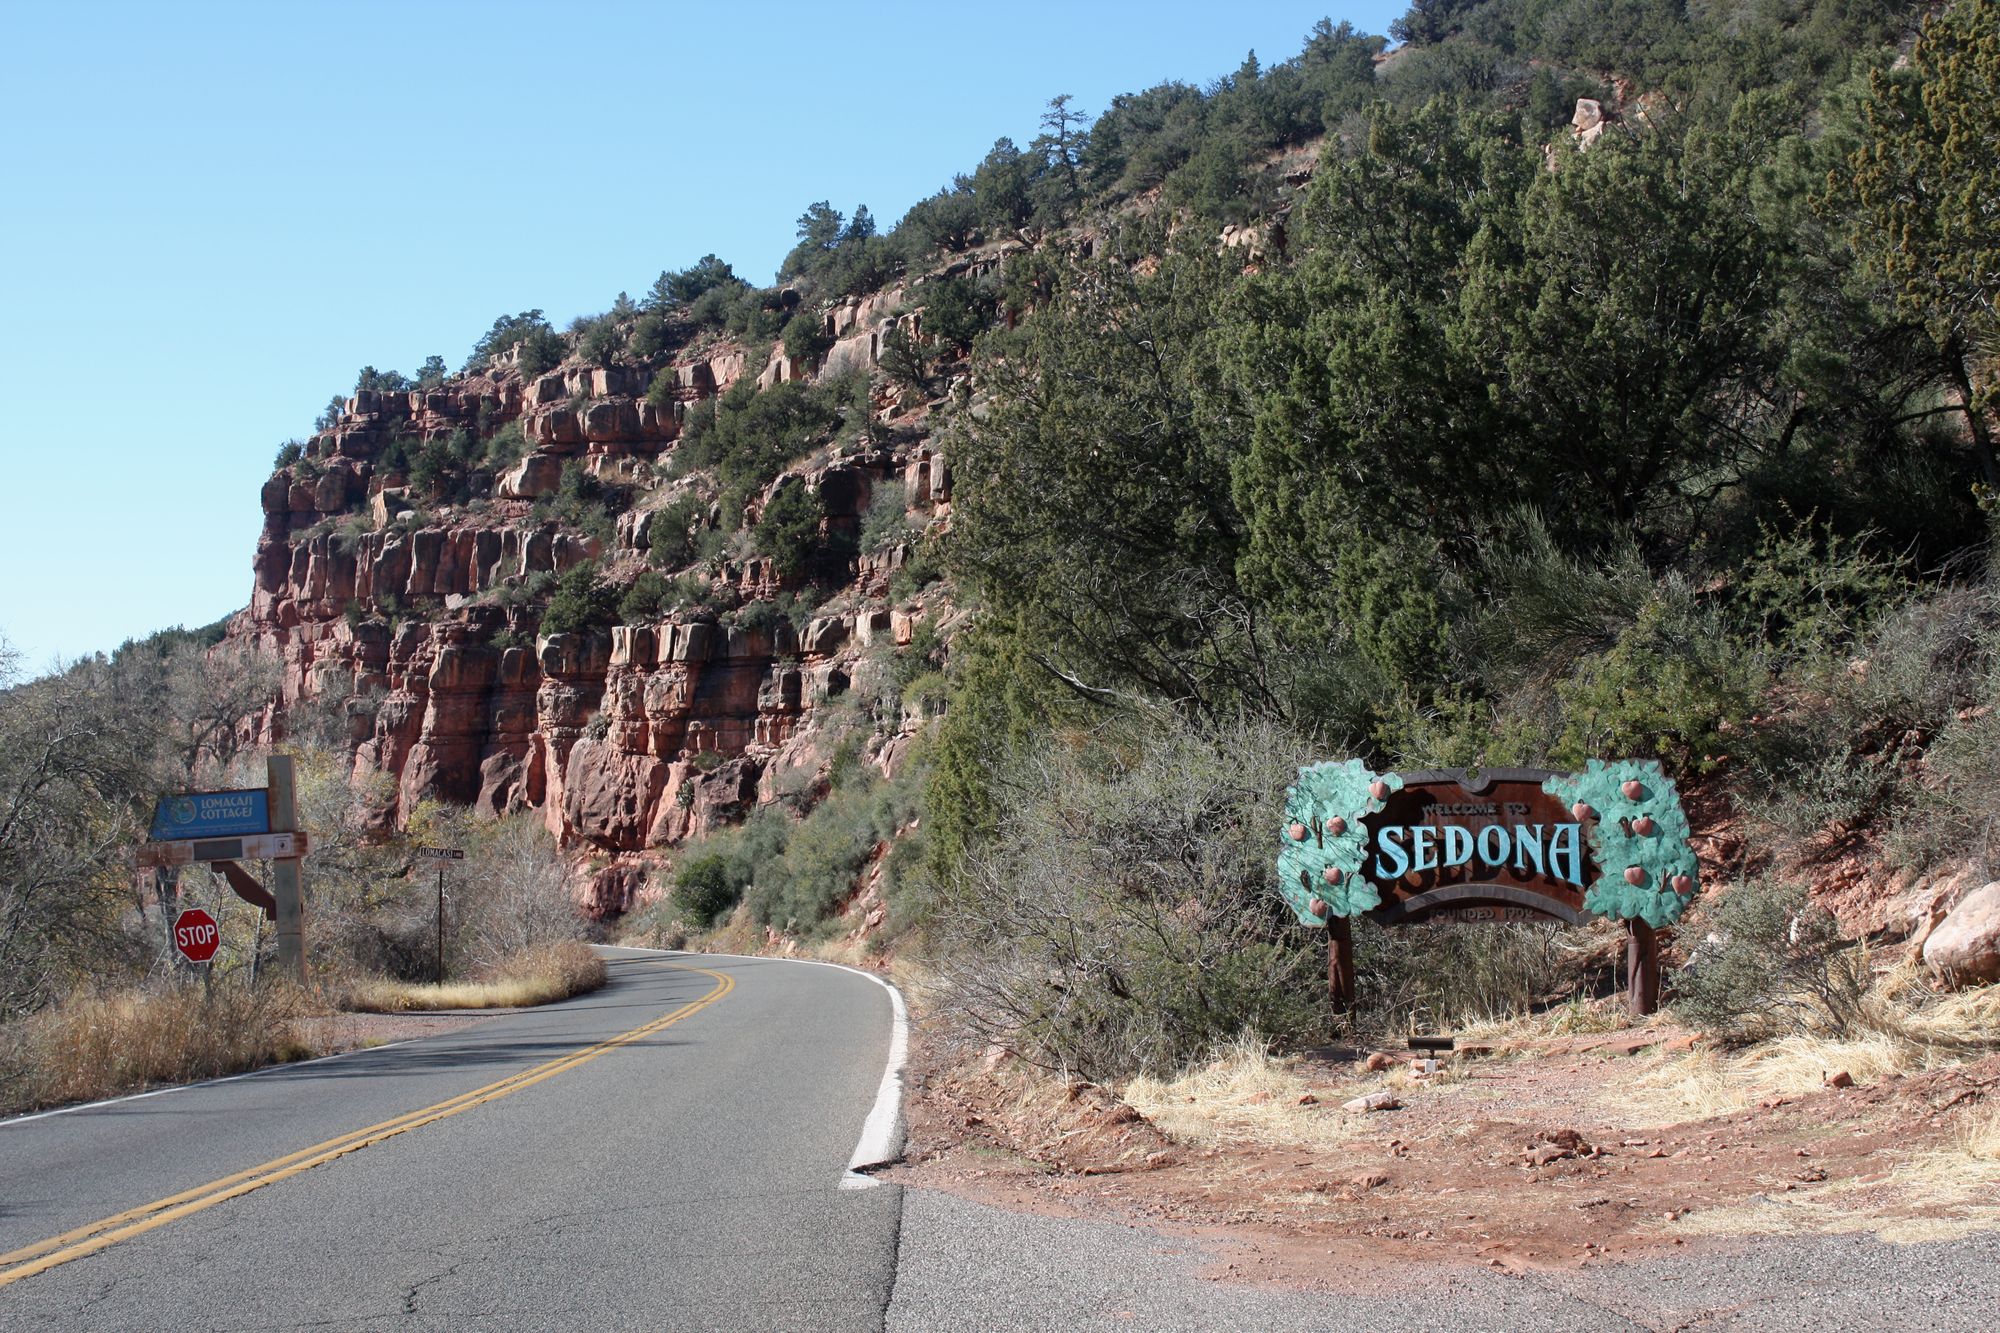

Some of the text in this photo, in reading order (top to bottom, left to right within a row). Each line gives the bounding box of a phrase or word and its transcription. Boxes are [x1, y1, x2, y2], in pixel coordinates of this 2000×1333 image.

[201, 796, 253, 809] LOMACASI
[1422, 802, 1529, 815] WELCOME TO
[200, 808, 253, 820] COTTAGES
[422, 848, 452, 858] LOMACASI
[1376, 823, 1583, 887] SEDONA
[1429, 908, 1495, 919] FOUNDED
[178, 925, 216, 947] STOP
